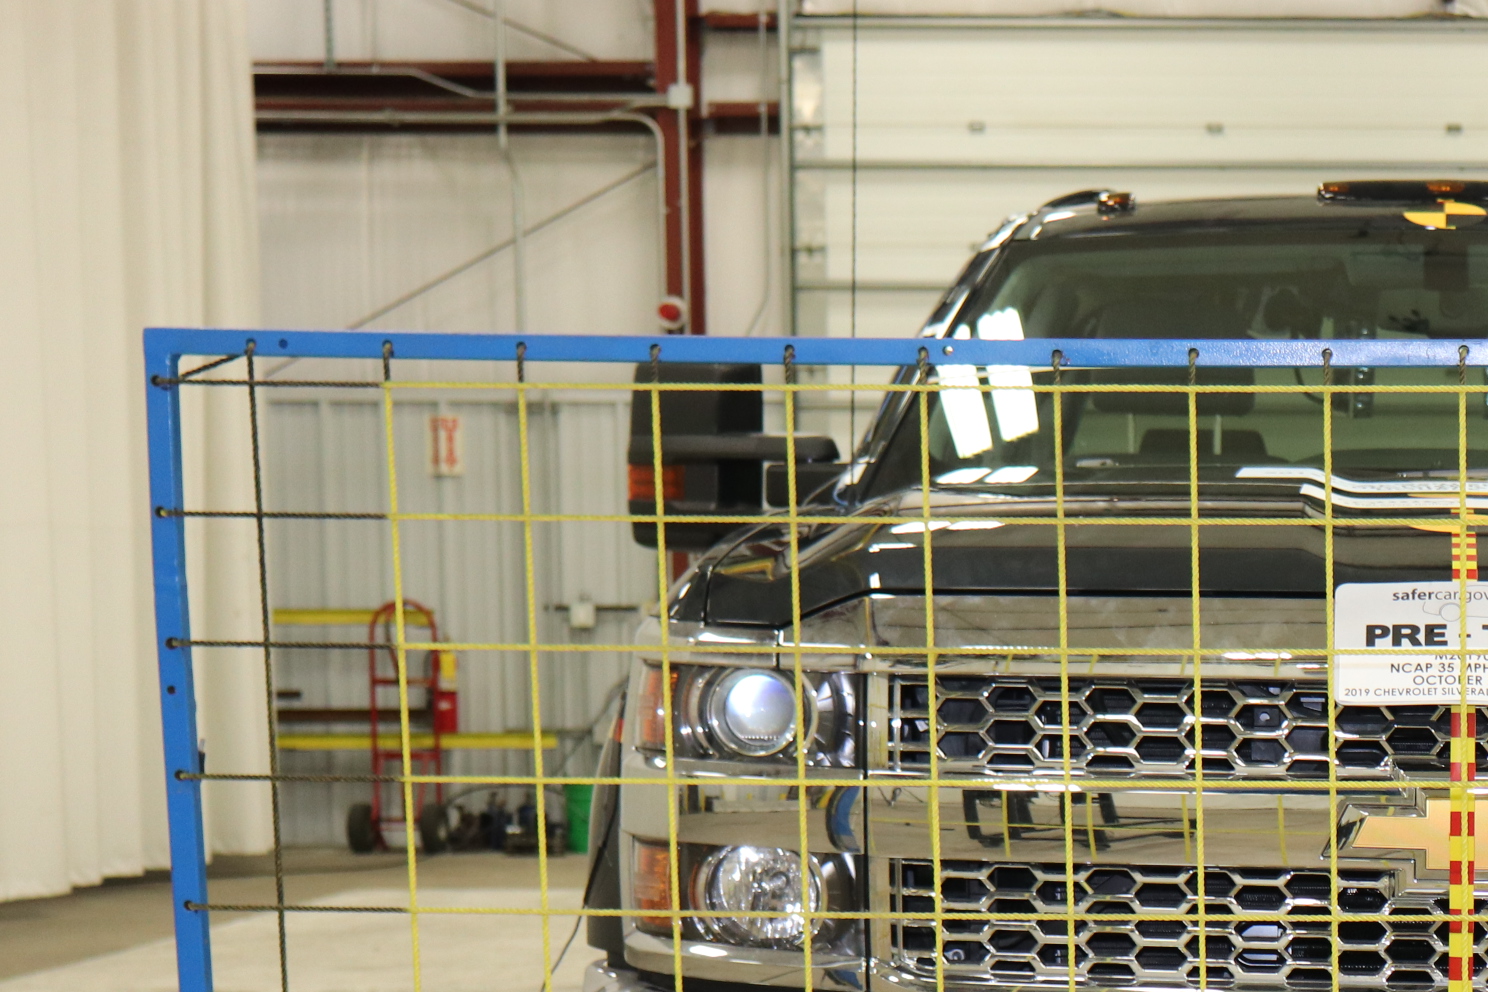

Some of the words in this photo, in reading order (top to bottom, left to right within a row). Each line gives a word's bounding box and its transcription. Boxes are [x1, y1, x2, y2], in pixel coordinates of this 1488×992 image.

[1366, 624, 1448, 647] PRE
[1390, 663, 1433, 673] NCAP
[1438, 662, 1455, 673] 35
[1344, 688, 1371, 696] 2019
[1374, 687, 1438, 696] CHEVROLET
